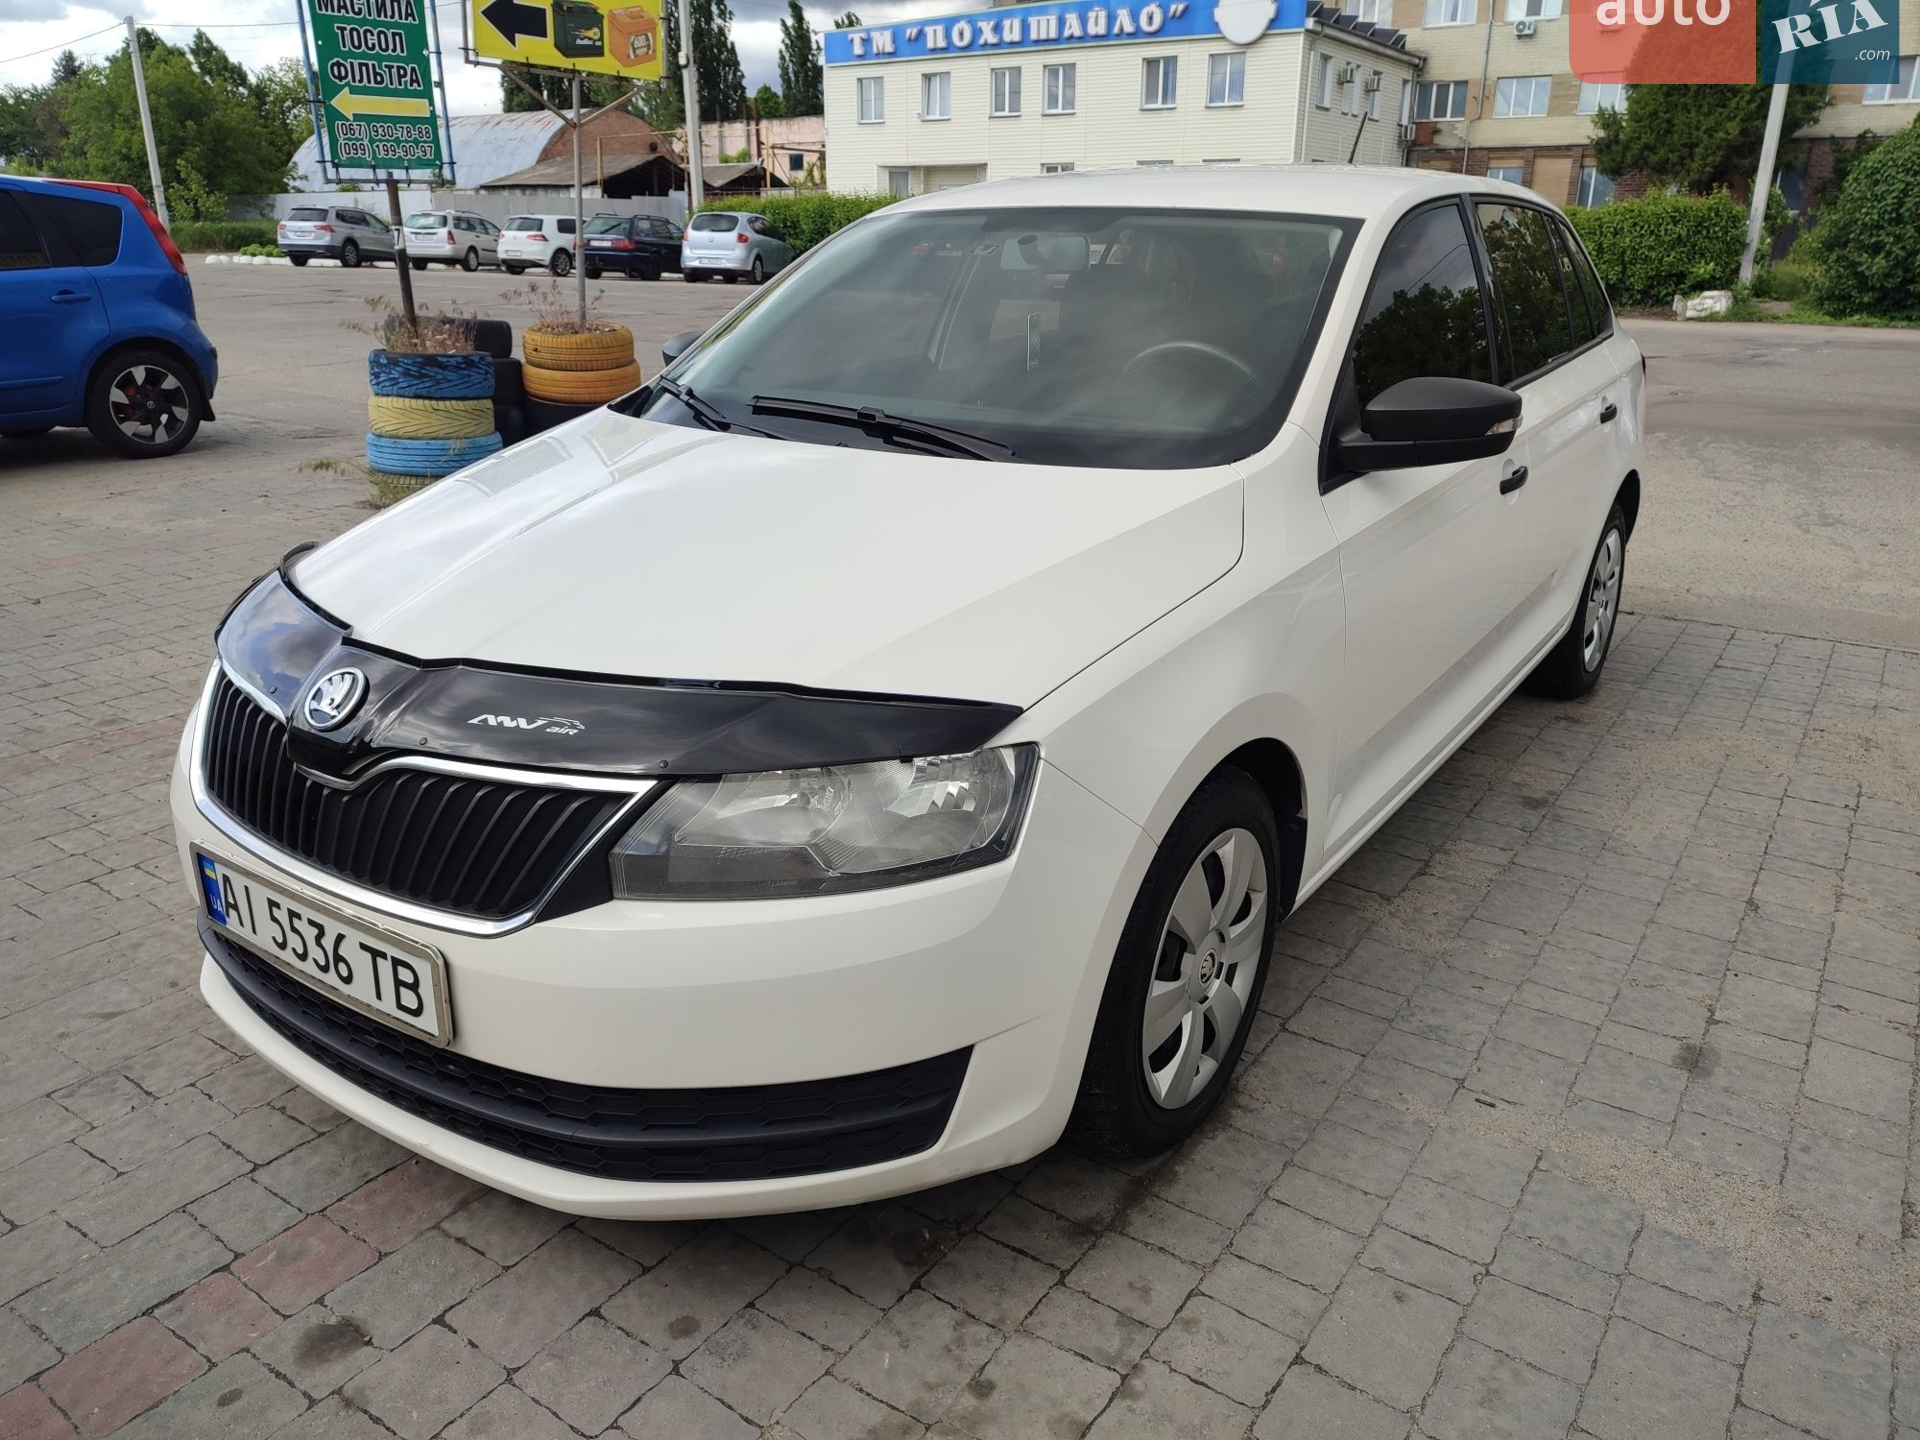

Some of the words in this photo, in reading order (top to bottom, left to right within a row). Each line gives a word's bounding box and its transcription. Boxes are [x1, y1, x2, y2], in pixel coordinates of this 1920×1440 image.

[335, 24, 406, 55] ТОСОЛ
[848, 30, 895, 56] ТМ
[328, 58, 423, 89] ФІЛЬТРА
[335, 121, 369, 140] (067)
[371, 123, 432, 140] 930-78-88
[339, 140, 372, 159] (099)
[374, 142, 434, 158] 199-90-97
[210, 893, 225, 915] UA
[266, 897, 354, 985] 5536
[359, 940, 424, 1018] TB
